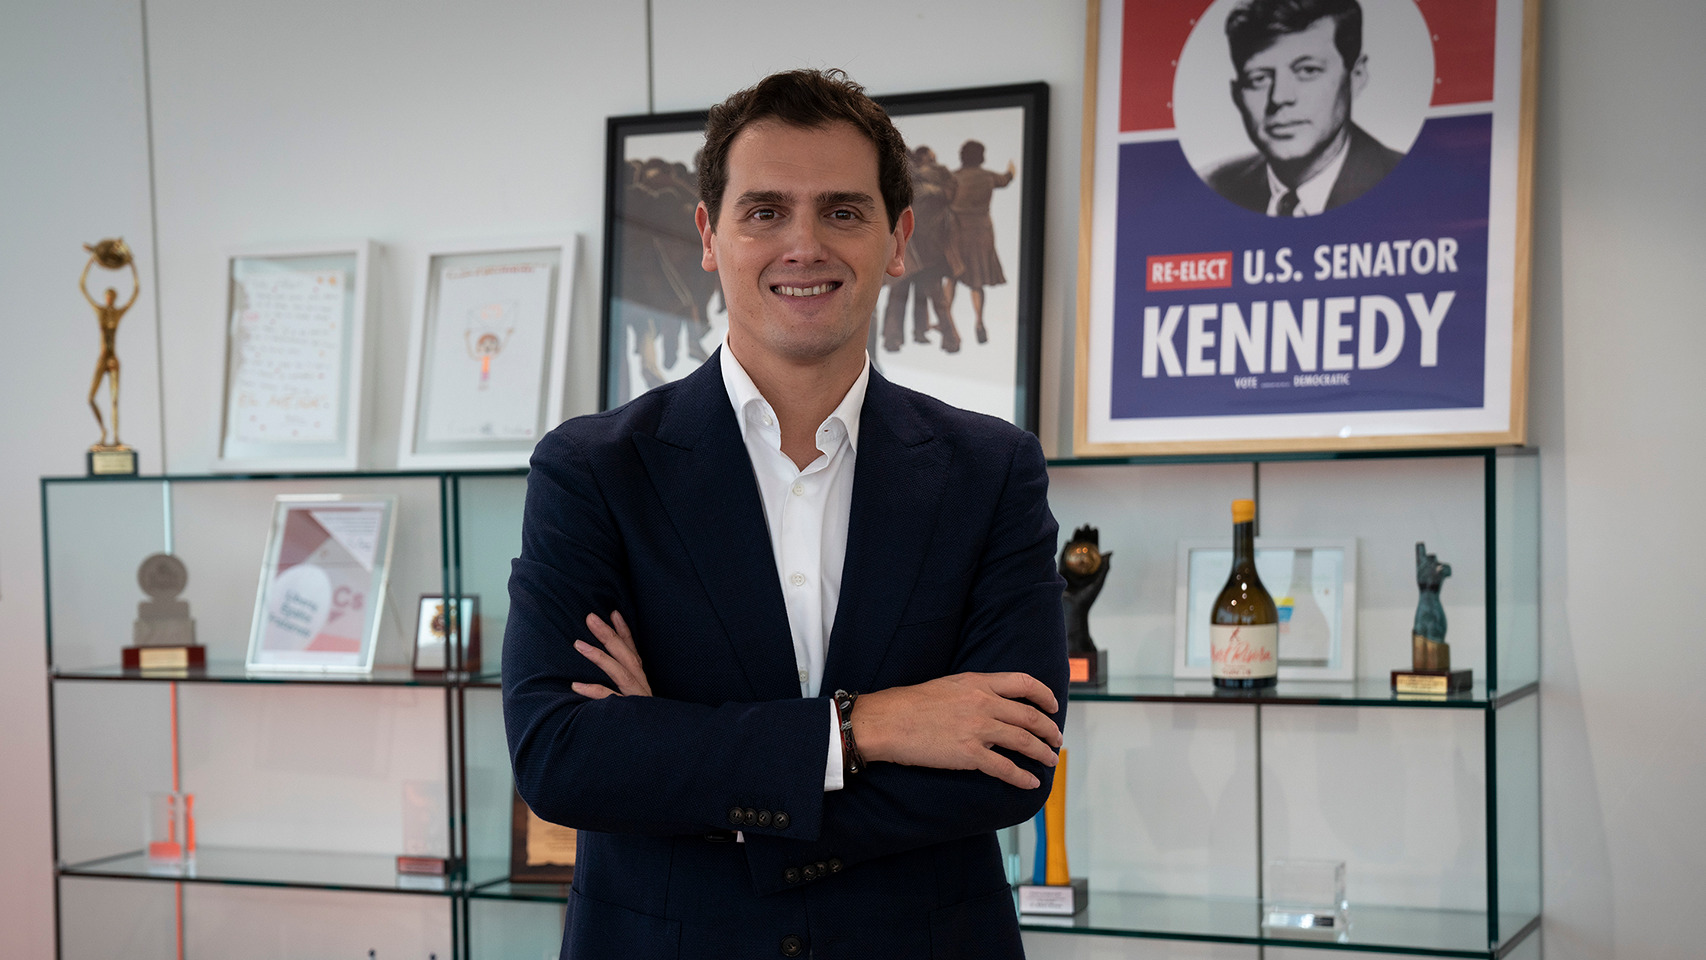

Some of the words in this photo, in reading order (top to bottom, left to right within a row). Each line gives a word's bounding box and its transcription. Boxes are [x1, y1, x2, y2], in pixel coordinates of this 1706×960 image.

[1151, 258, 1228, 283] RE-ELECT
[1243, 248, 1303, 285] U.S.
[1313, 237, 1459, 281] SENATOR
[1142, 291, 1456, 378] KENNEDY
[1234, 376, 1258, 389] VOTE
[1293, 372, 1351, 387] DEMOCRATIC
